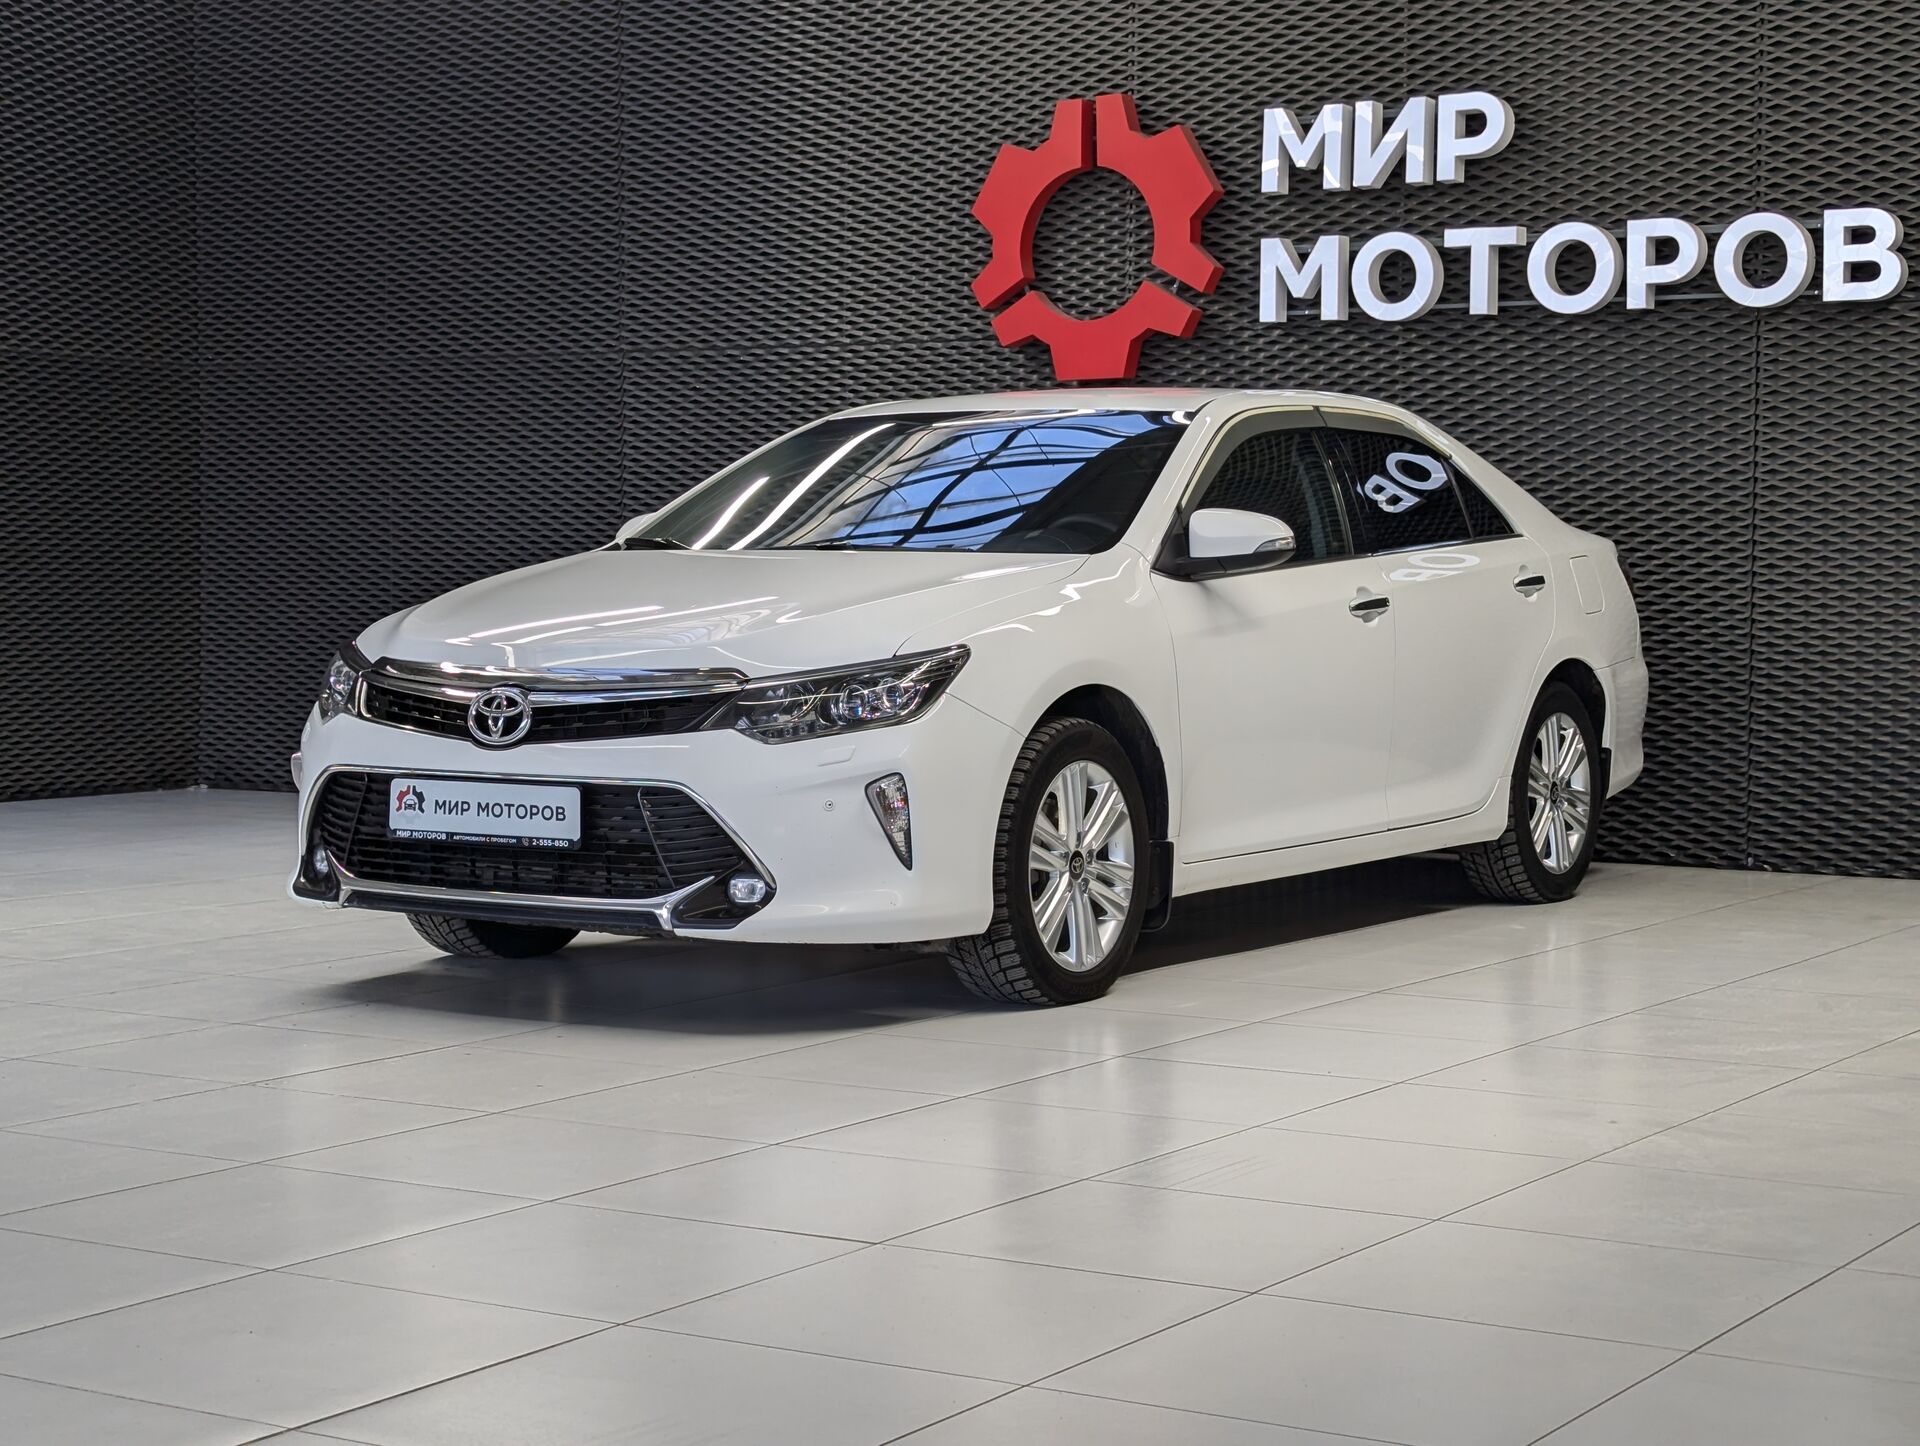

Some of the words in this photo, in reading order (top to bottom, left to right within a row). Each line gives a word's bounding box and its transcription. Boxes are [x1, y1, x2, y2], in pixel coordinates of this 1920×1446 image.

[1261, 91, 1515, 195] МИР
[1259, 207, 1908, 323] МОТОРОВ
[434, 799, 471, 816] МИР
[476, 802, 567, 822] МОТОРОВ
[396, 830, 411, 838] МИР
[412, 831, 447, 840] МОТОРОВ
[452, 834, 485, 842] АВТОМОБИЛИ
[490, 836, 517, 844] ПРОБЕГОМ
[532, 838, 569, 848] 2-555-850
